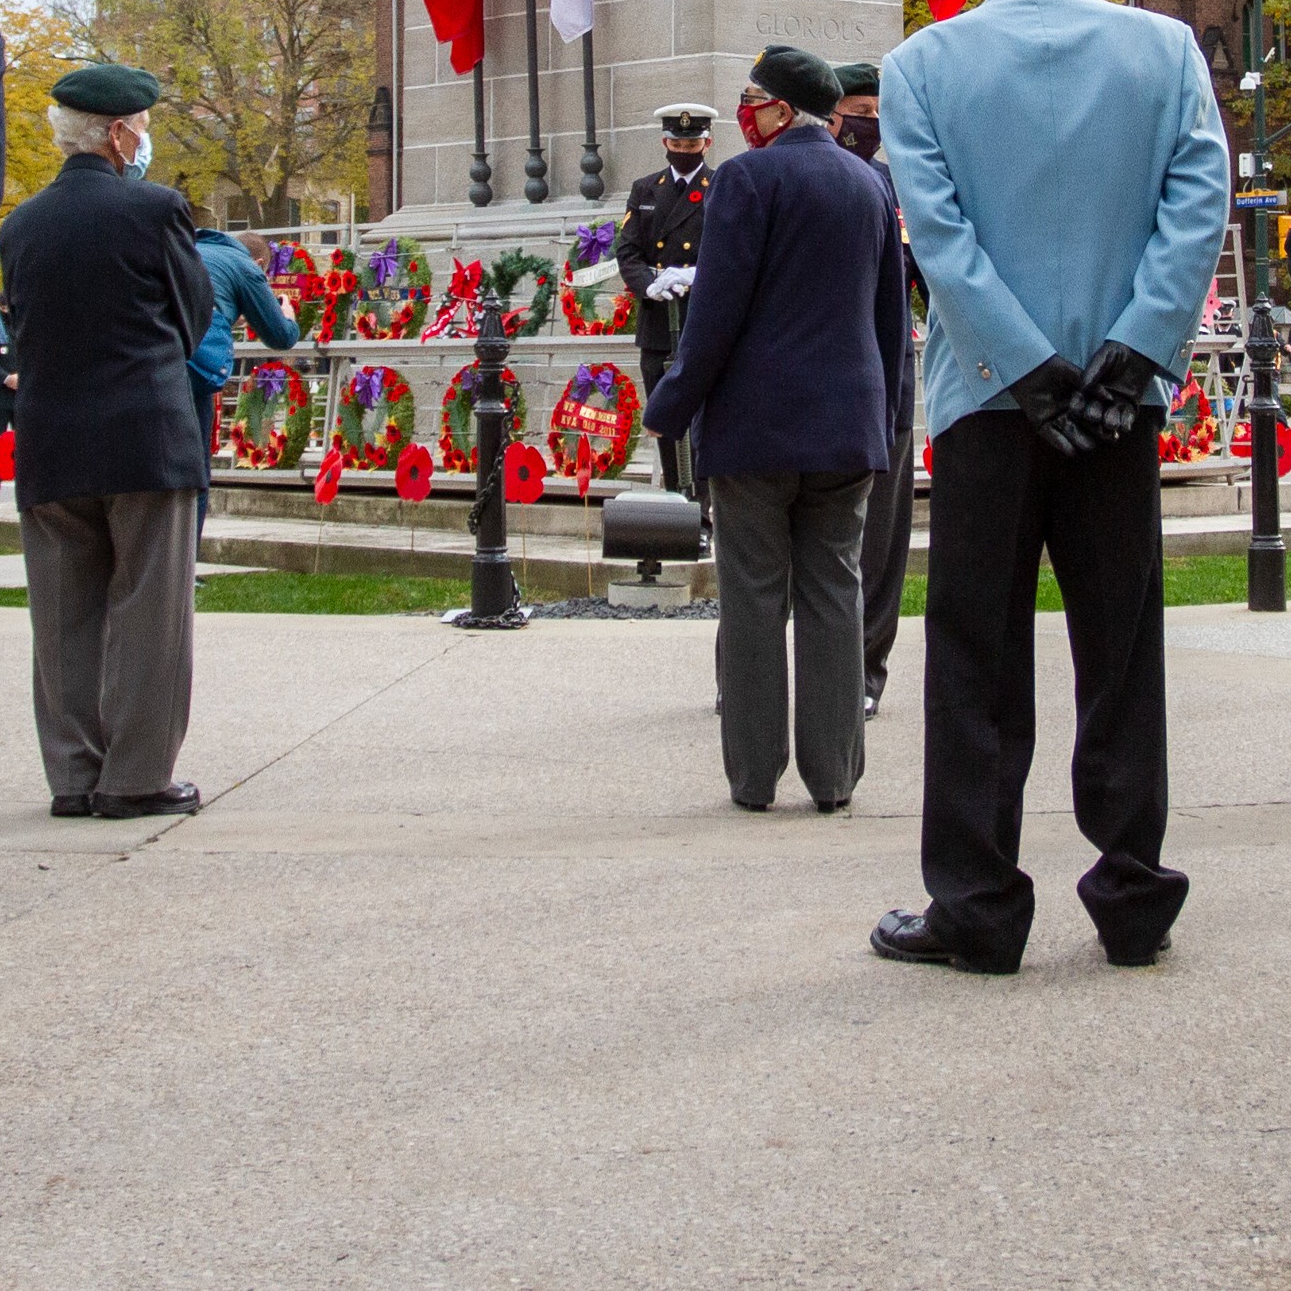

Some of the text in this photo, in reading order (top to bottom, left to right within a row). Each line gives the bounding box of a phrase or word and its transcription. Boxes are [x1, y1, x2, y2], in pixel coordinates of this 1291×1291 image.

[756, 12, 865, 42] GLORIOUS
[1236, 196, 1277, 206] Dufferin Ave
